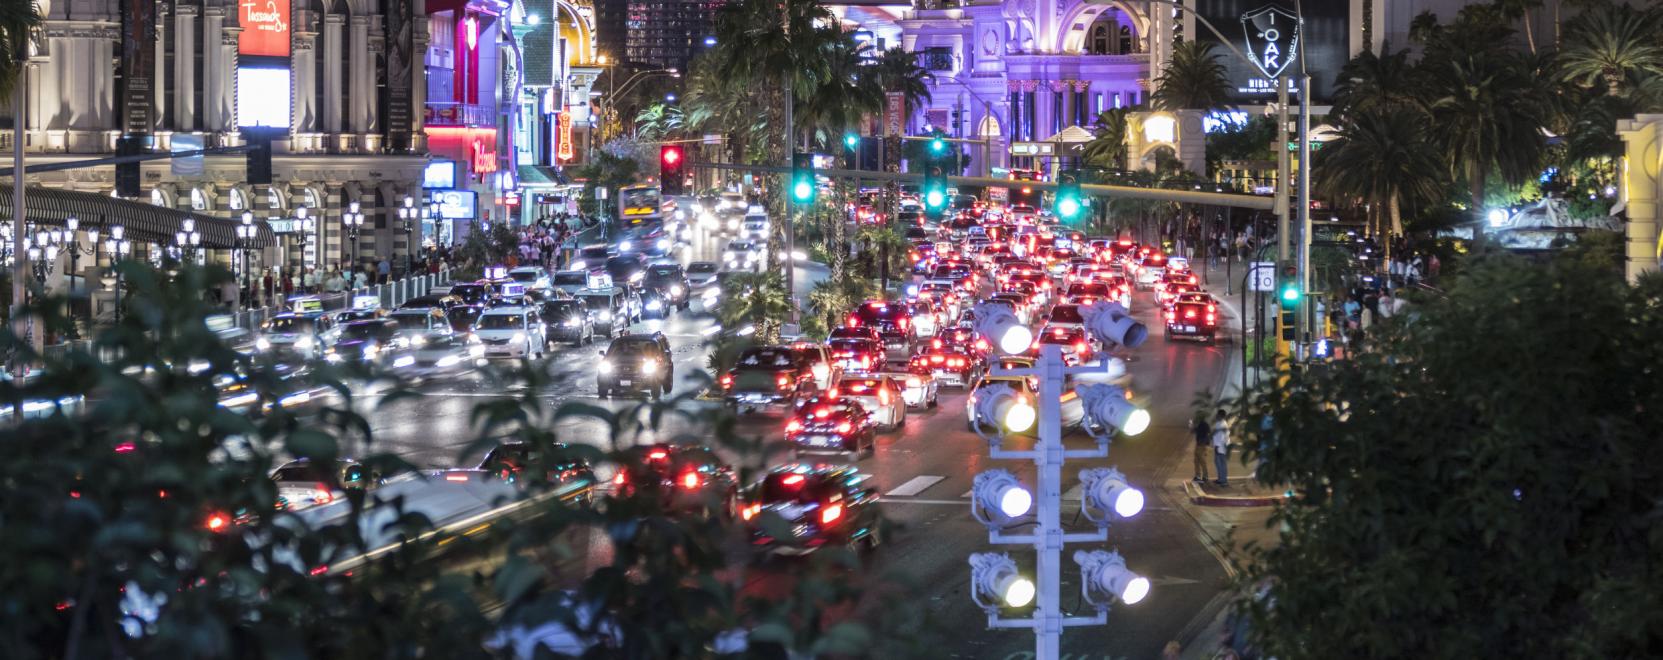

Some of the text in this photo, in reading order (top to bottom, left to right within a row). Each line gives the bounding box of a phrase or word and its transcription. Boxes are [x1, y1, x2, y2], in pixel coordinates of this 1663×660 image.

[1264, 12, 1279, 68] 1 OAK
[1249, 79, 1294, 88] NIGHCB
[889, 96, 899, 135] LAS VEGAS
